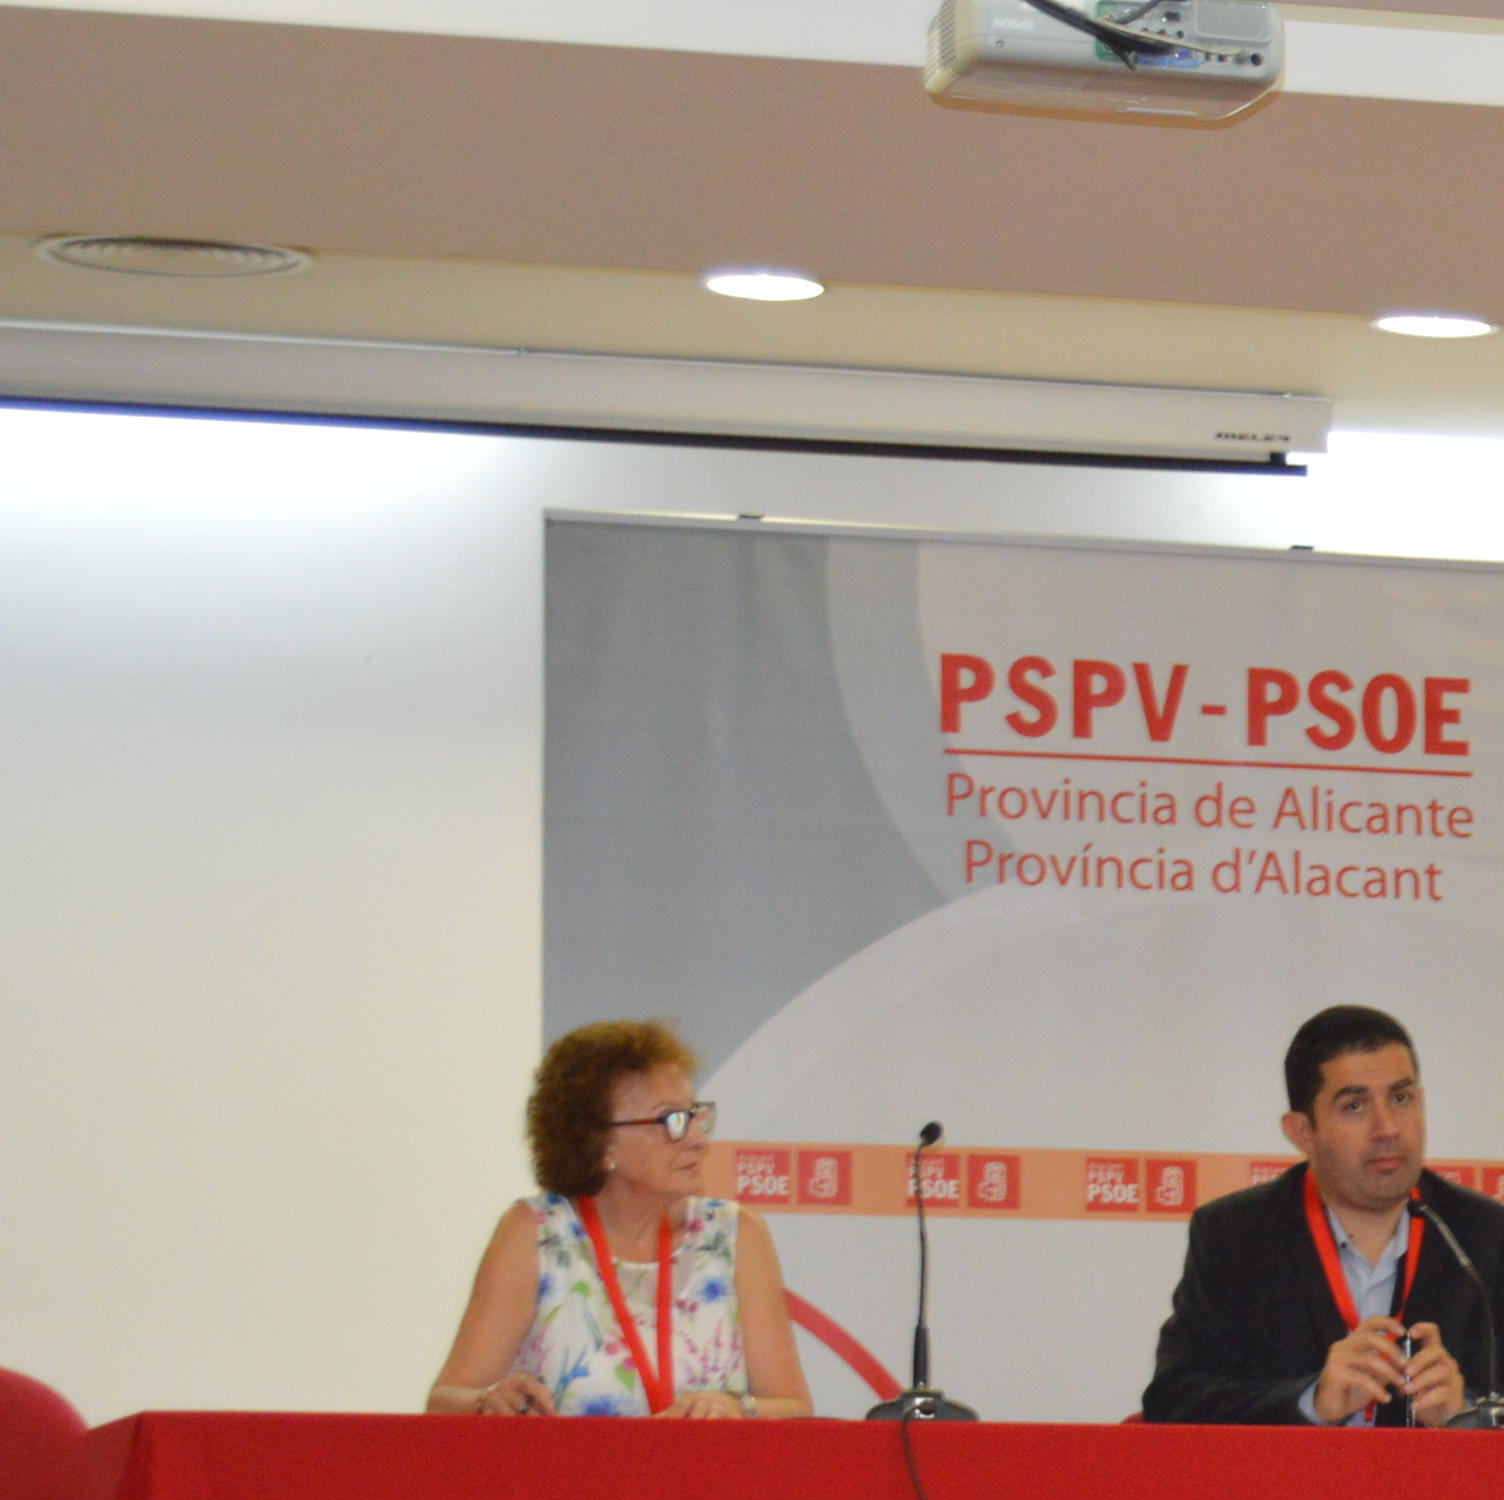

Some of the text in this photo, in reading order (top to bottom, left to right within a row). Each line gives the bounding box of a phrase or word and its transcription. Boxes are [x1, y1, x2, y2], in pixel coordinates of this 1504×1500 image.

[947, 772, 1475, 838] Provincia de Alicante
[965, 842, 1443, 901] Província d'Alacant
[737, 1175, 790, 1195] PSOE
[1088, 1169, 1125, 1183] PSPV
[1088, 1184, 1139, 1203] PSOE
